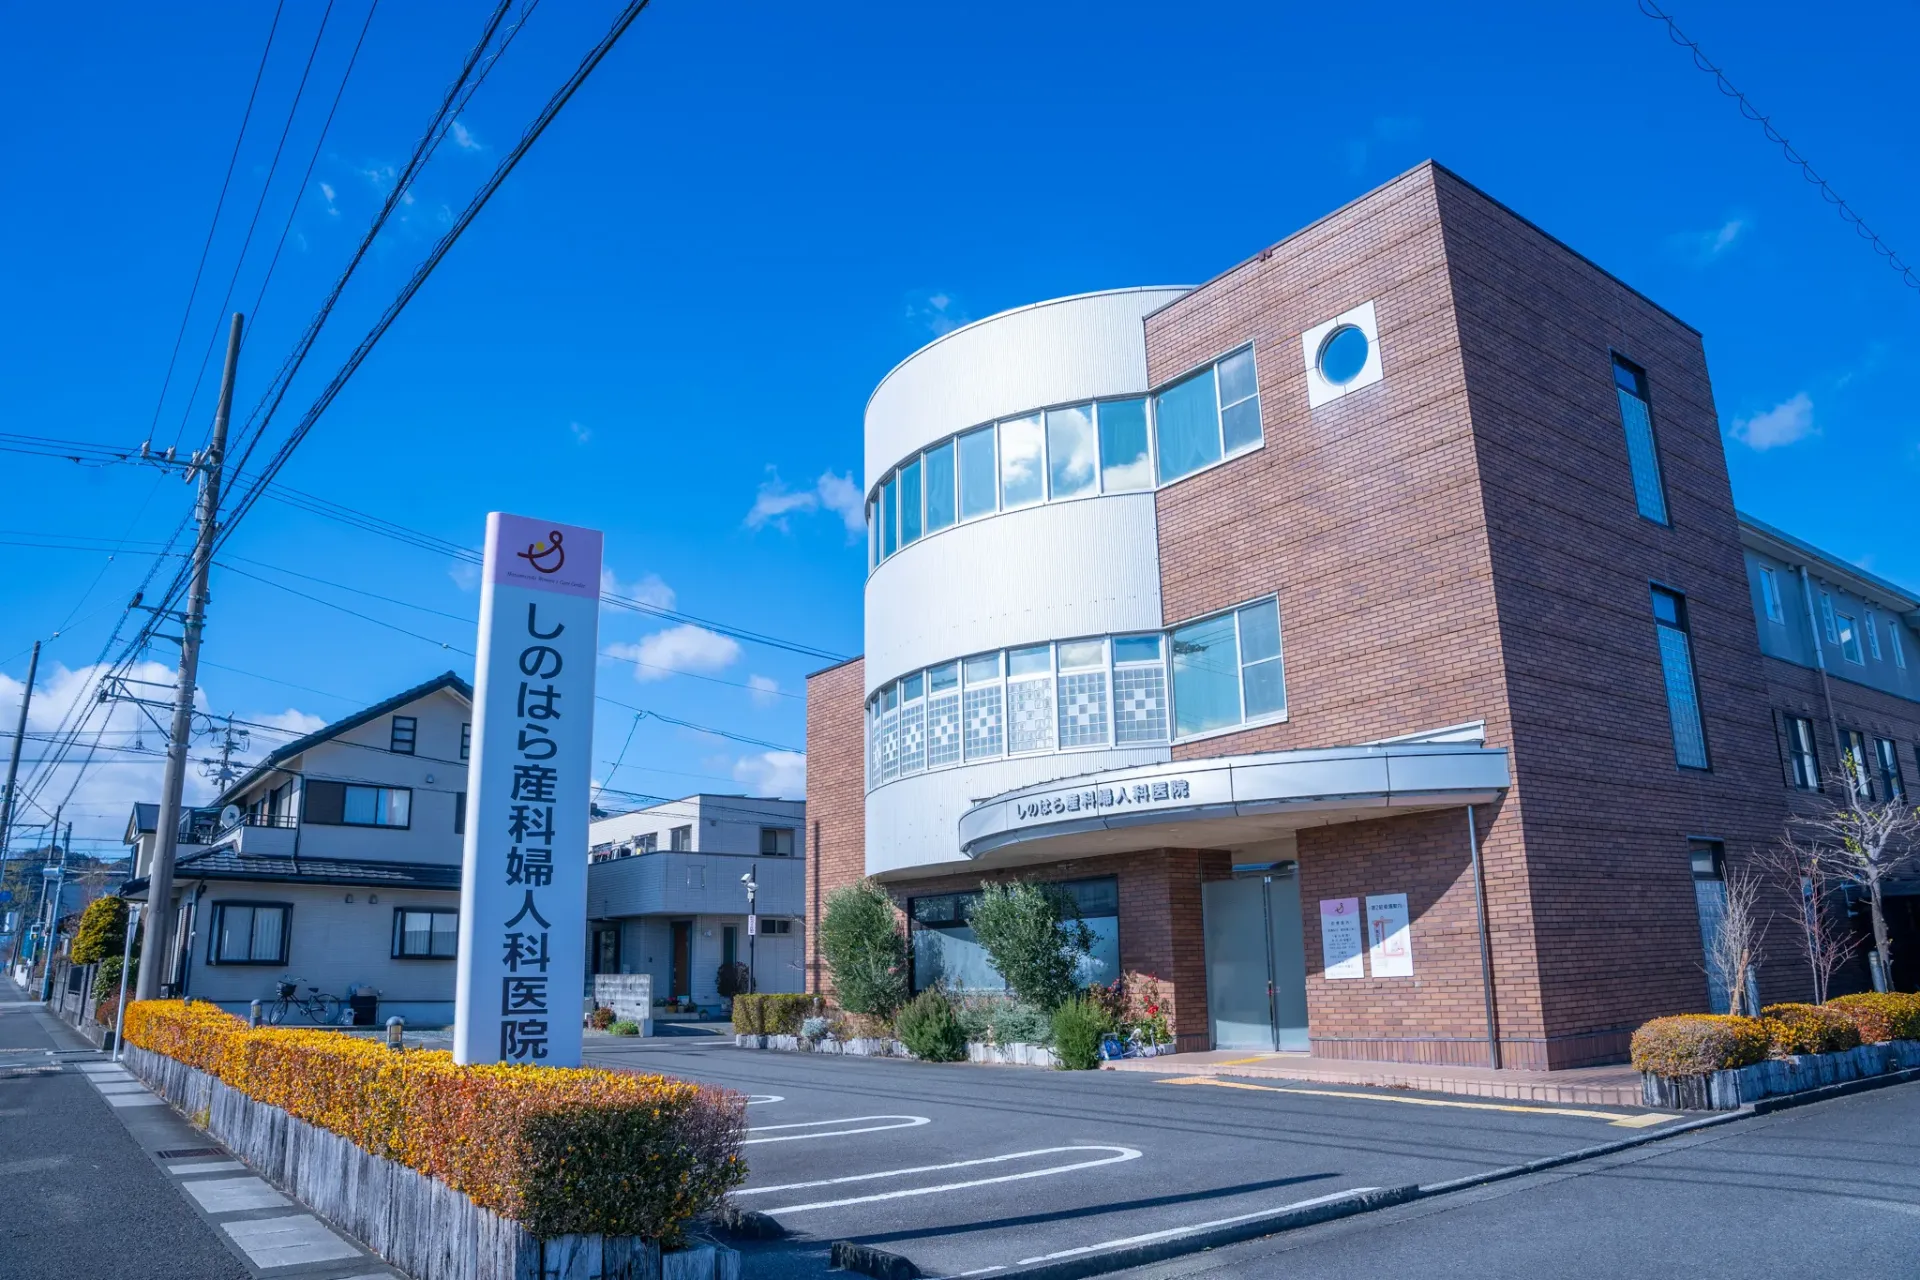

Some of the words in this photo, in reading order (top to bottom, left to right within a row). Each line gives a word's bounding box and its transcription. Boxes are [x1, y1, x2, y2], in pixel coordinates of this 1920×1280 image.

[501, 602, 564, 1062] しのはら産科婦人科医院
[1016, 779, 1190, 820] しのはら産科婦人科医院
